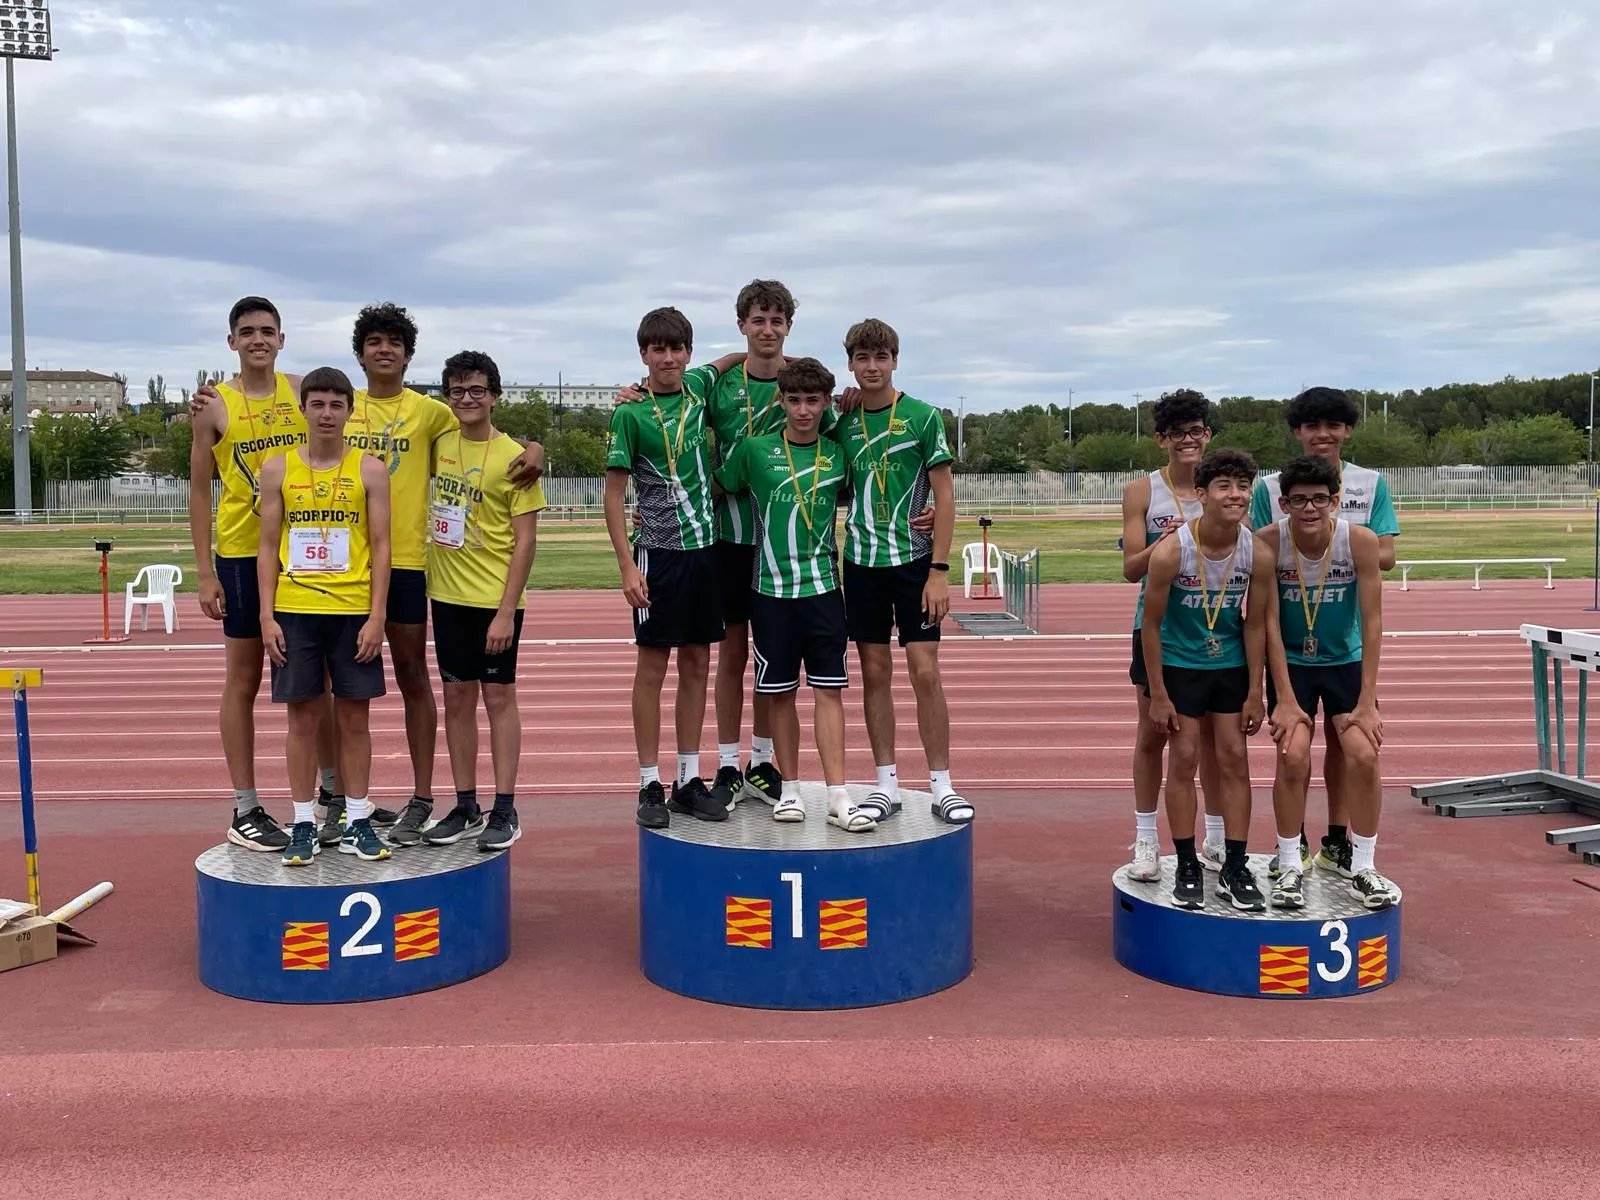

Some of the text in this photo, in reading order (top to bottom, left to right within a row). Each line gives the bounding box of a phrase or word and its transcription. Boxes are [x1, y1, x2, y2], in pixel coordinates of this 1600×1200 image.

[240, 432, 307, 454] SCORPIO-71
[289, 509, 360, 524] SCORPIO-71
[435, 519, 449, 534] 38
[305, 545, 328, 560] 58
[781, 872, 803, 938] 1
[339, 891, 383, 957] 2
[1316, 919, 1352, 982] 3
